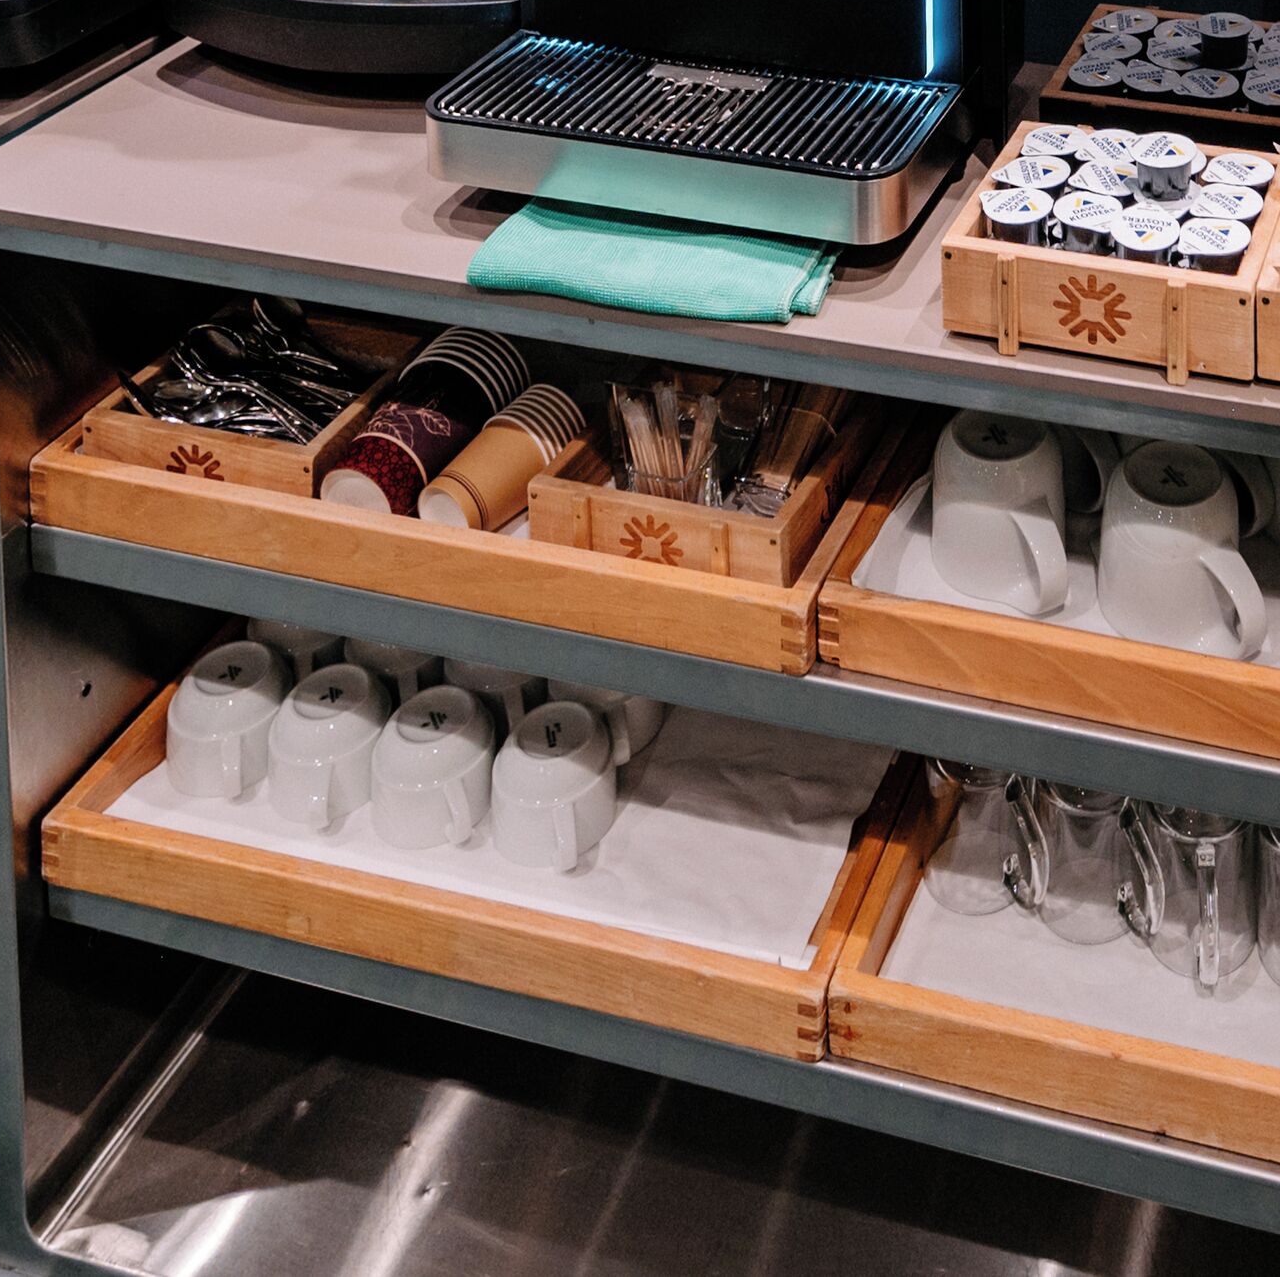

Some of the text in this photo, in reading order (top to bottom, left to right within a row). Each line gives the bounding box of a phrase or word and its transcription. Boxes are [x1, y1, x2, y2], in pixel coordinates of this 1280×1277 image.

[1032, 133, 1065, 151] KLOSTERS
[1042, 131, 1068, 147] DAVOS
[1139, 134, 1168, 159] KLOSTERS
[1151, 140, 1173, 159] DAVOS
[1019, 160, 1033, 185] KLOSTERS
[1028, 160, 1042, 181] DAVOS
[1101, 165, 1120, 187] DAVOS
[1216, 159, 1247, 182] KLOSTERS
[1227, 160, 1250, 176] DAVOS
[1090, 163, 1114, 193] KLOSTERS
[993, 190, 1026, 213] KLOSTERS
[1005, 194, 1031, 212] DAVOS
[1072, 203, 1105, 215] DAVOS
[1202, 191, 1238, 216] KLOSTERS
[1215, 192, 1242, 208] DAVOS
[1069, 207, 1116, 223] KLOSTERS
[1122, 215, 1172, 227] KLOSTERS
[1128, 222, 1163, 233] DAVOS
[1200, 225, 1228, 244] DAVOS
[1187, 226, 1226, 251] KLOSTERS
